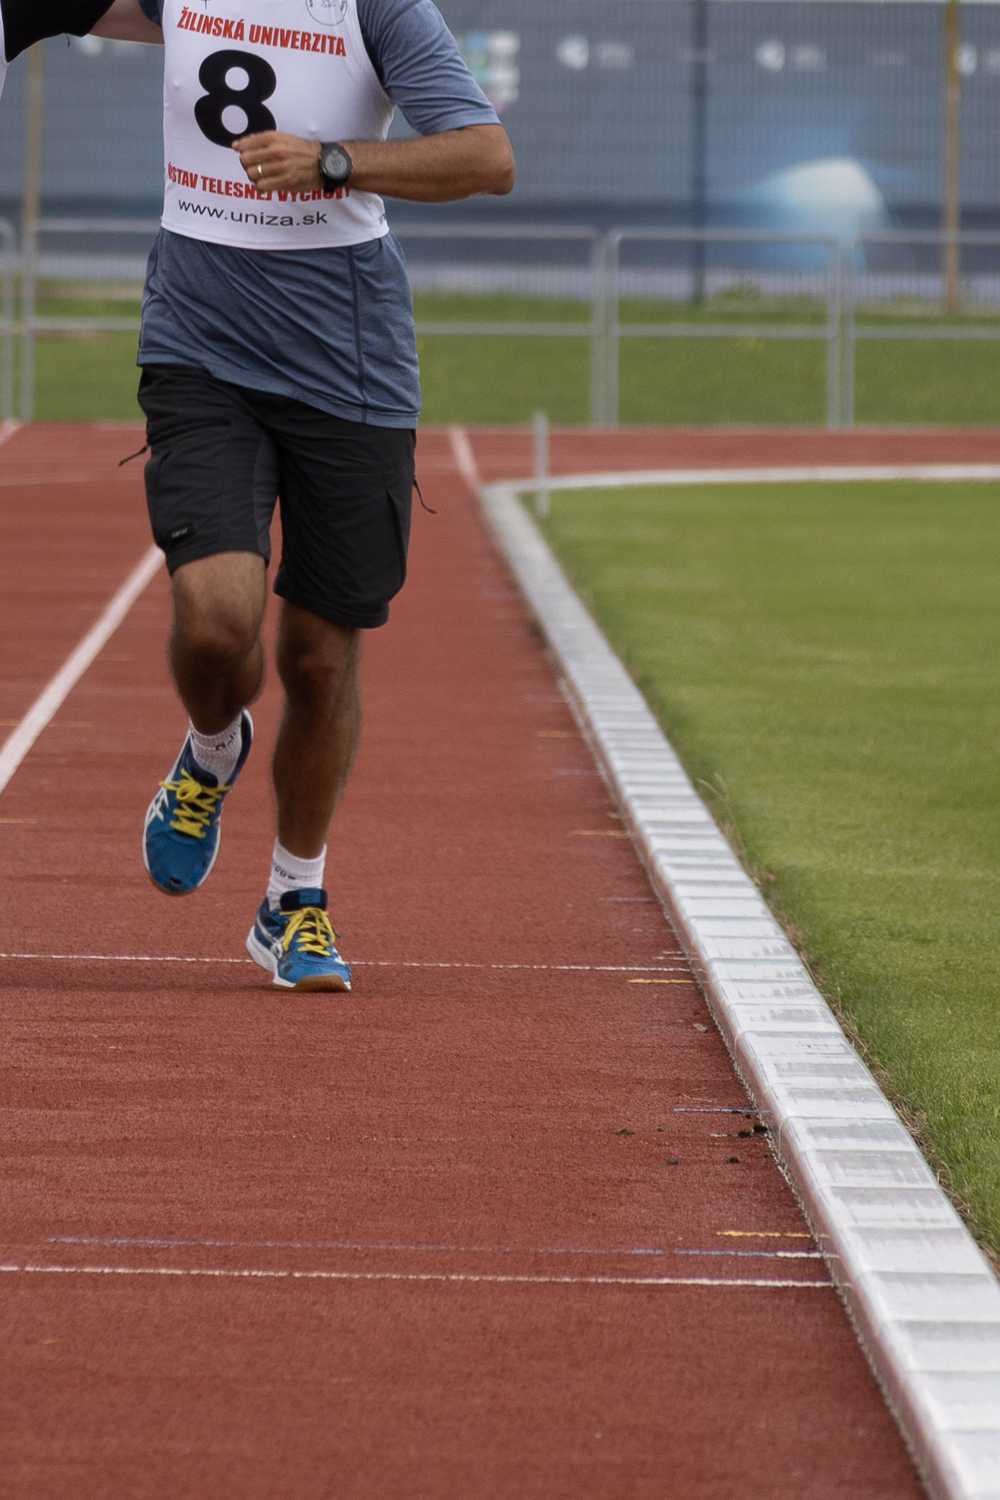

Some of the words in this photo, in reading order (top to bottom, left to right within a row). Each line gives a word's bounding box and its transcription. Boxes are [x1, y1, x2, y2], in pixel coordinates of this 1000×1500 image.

[177, 6, 245, 41] ŽILINSKÁ
[249, 24, 347, 57] UNIVERZITA
[193, 49, 277, 149] 8
[168, 161, 198, 189] ÚSTAV
[201, 175, 272, 201] TELESNEJ
[178, 199, 328, 227] www.uniza.sk
